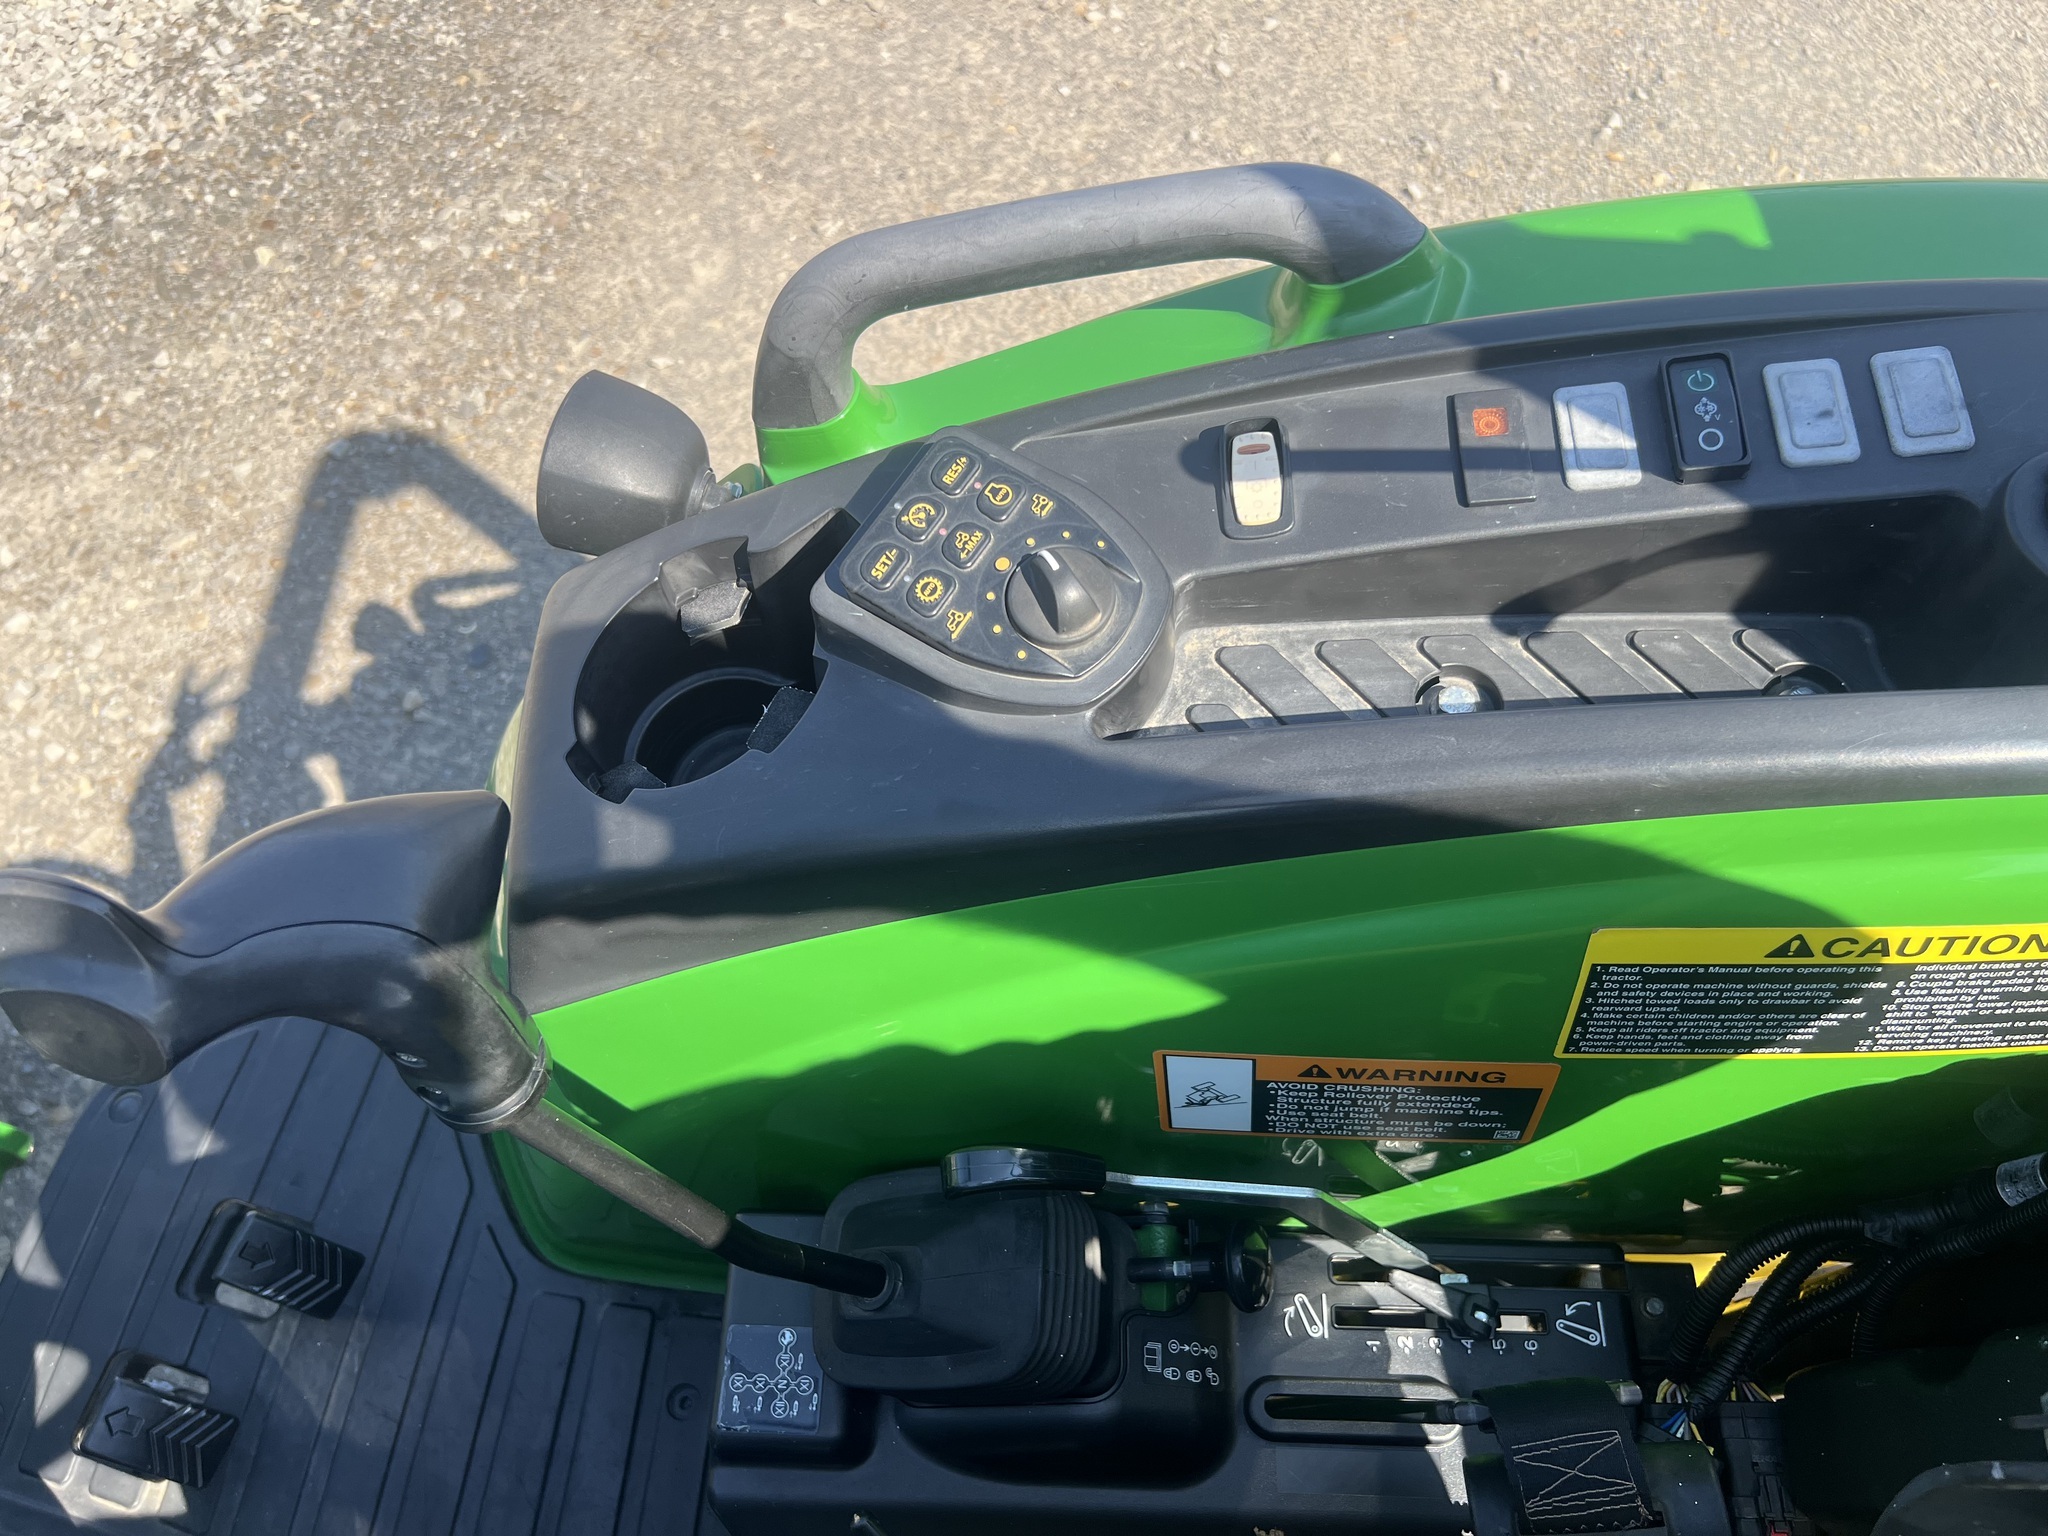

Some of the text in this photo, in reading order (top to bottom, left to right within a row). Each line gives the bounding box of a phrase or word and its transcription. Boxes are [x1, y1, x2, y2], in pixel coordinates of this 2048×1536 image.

[942, 457, 967, 485] RES/+
[995, 487, 1007, 502] AUTO
[964, 531, 983, 552] MAX
[923, 582, 935, 597] AUTO
[1915, 964, 1975, 972] Individual
[1979, 962, 2021, 970] brakes
[1929, 972, 1966, 980] rough
[1969, 970, 2015, 978] ground
[1909, 980, 1952, 988] Couple
[1993, 977, 2034, 986] pedals
[1932, 987, 1980, 995] flashing
[1983, 985, 2032, 993] warning
[1894, 996, 1961, 1004] prohibited
[1976, 1000, 2011, 1008] lower
[1880, 1017, 1957, 1025] dismounting.
[1951, 1021, 2012, 1029] movement
[1336, 1068, 1507, 1083] WARNING
[1267, 1082, 1421, 1093] AVOID CRUSHING:
[1277, 1097, 1351, 1105] Structure
[1397, 1094, 1481, 1102] Protective
[1334, 1105, 1374, 1113] jump
[1314, 1117, 1384, 1125] structure
[1397, 1336, 1414, 1350] 2
[1428, 1337, 1443, 1349] 3
[1461, 1339, 1473, 1348] 4
[1493, 1339, 1506, 1350] 5
[1525, 1340, 1537, 1350] 6
